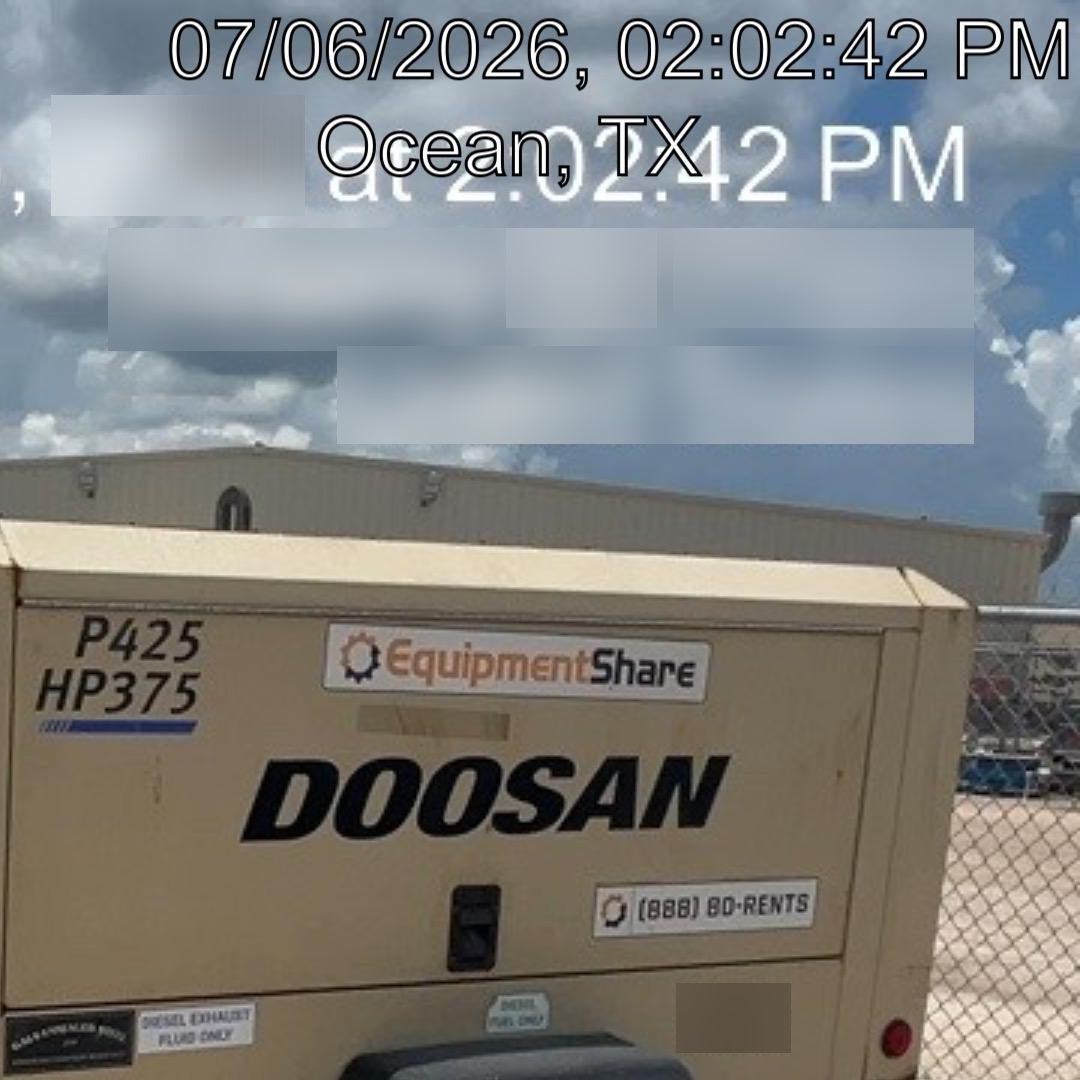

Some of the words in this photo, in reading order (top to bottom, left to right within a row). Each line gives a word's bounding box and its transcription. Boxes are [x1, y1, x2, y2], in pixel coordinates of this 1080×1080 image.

[75, 615, 204, 663] P425
[384, 638, 696, 688] EquipmentShare
[35, 668, 201, 715] HP375
[240, 755, 731, 843] DOOSAN
[142, 1013, 187, 1029] DIESEL
[190, 1008, 250, 1026] EXHAUST
[158, 1031, 195, 1047] FLUID
[199, 1028, 233, 1043] ONLY
